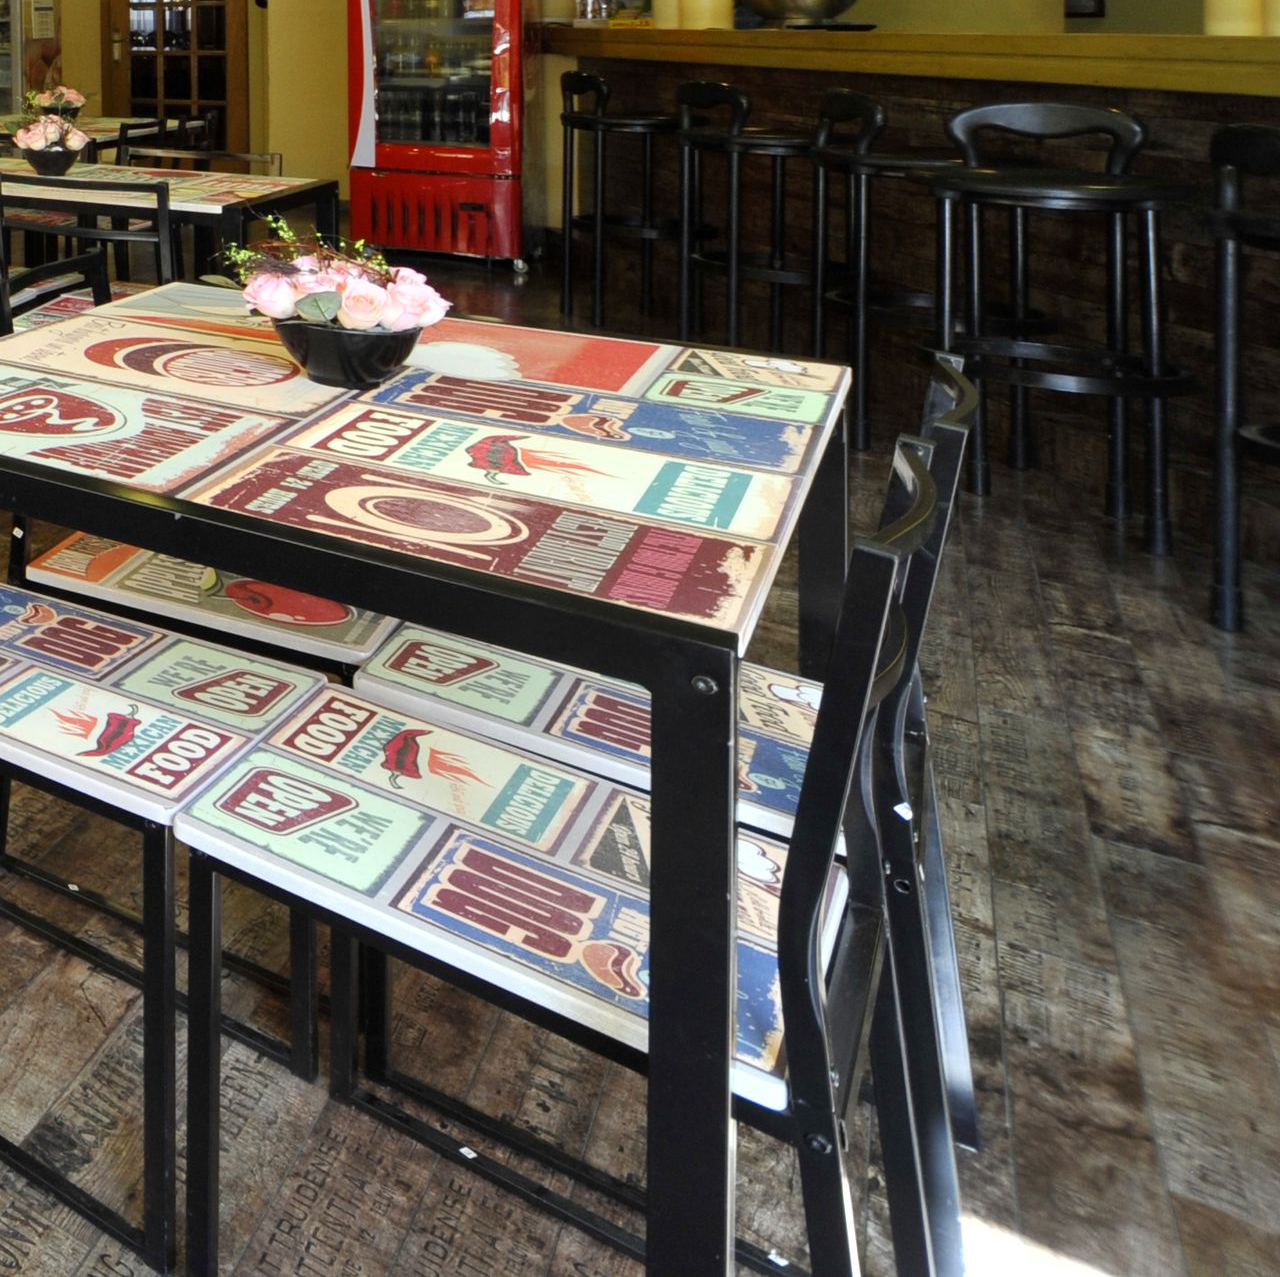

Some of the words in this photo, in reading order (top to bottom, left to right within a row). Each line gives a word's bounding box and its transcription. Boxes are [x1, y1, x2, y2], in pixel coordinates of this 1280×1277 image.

[325, 411, 429, 458] FOOD
[20, 615, 142, 669] DOG
[400, 642, 483, 683] OPEN
[146, 654, 228, 688] WE'RE
[193, 673, 280, 711] OPEN
[99, 713, 184, 771] MEXICAN
[133, 727, 222, 786] FOOD
[292, 700, 373, 757] FOOD
[336, 713, 409, 775] MEXICAN
[232, 774, 336, 829] OPEN
[493, 768, 563, 836] DELICIOUS
[295, 810, 395, 864] WE'RE
[434, 845, 599, 962] DOG
[268, 1125, 349, 1252] TRUIDENSE
